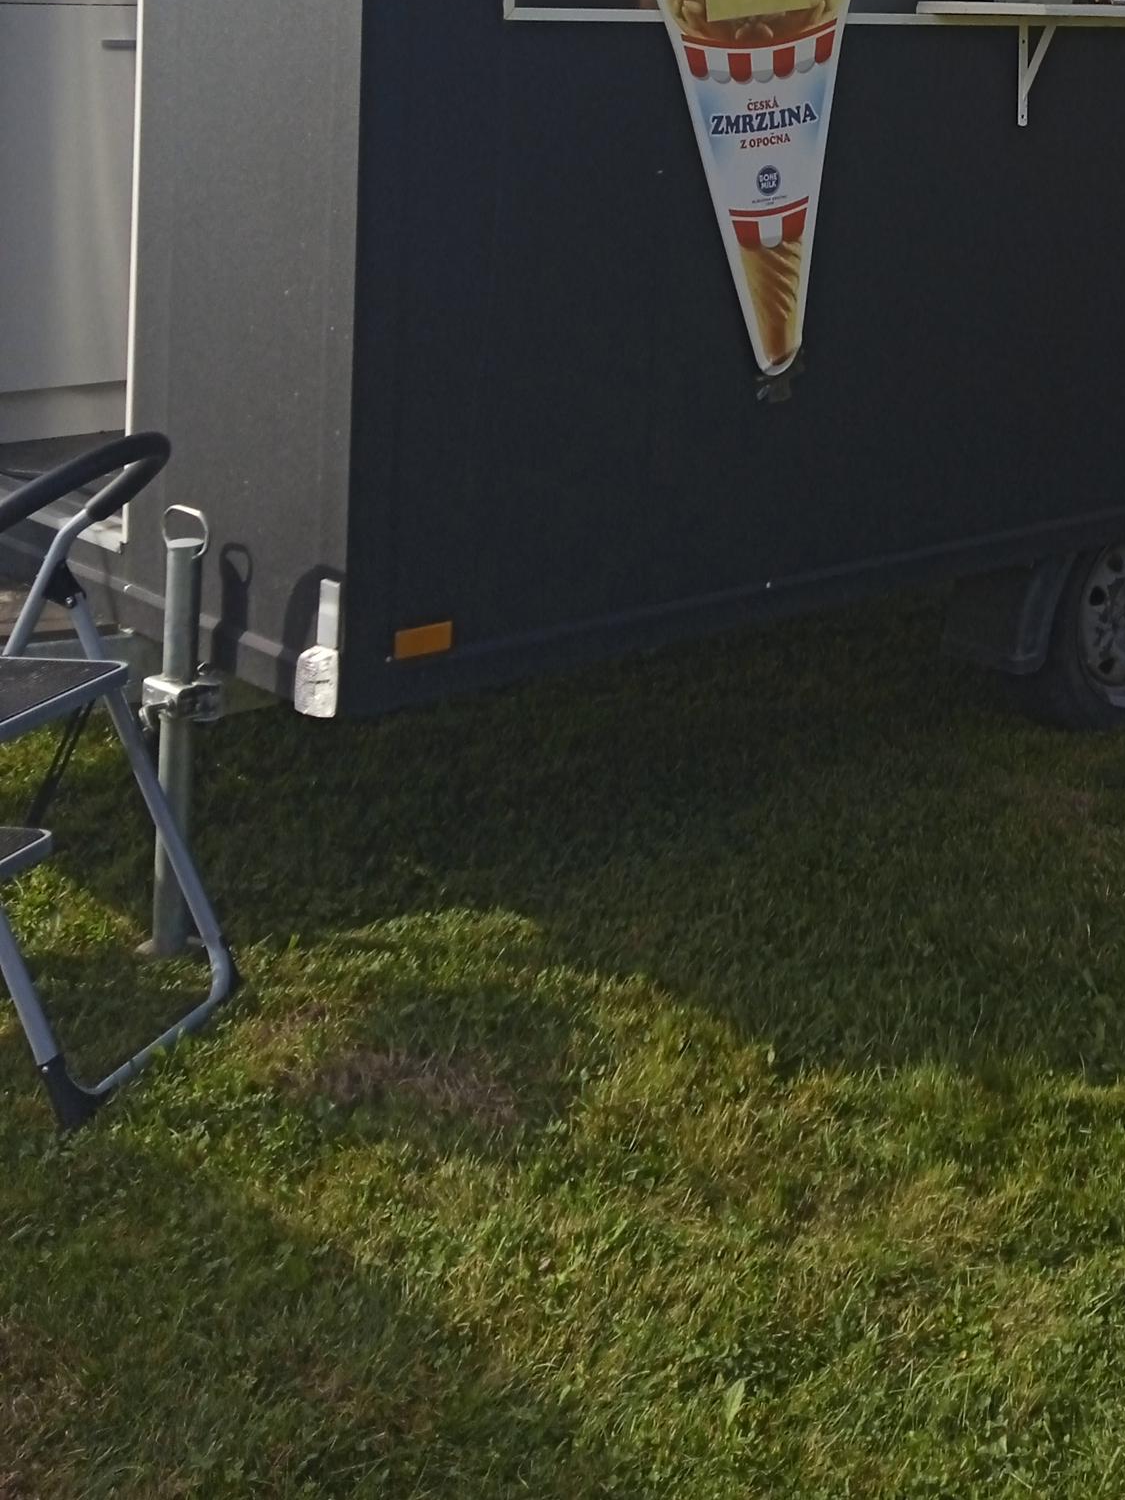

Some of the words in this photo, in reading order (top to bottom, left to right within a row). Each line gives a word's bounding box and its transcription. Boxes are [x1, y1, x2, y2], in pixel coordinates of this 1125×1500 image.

[747, 97, 779, 112] ČESKÁ
[711, 103, 817, 136] ZMRZLINA
[740, 139, 748, 149] Z
[749, 132, 791, 149] OPOČNA
